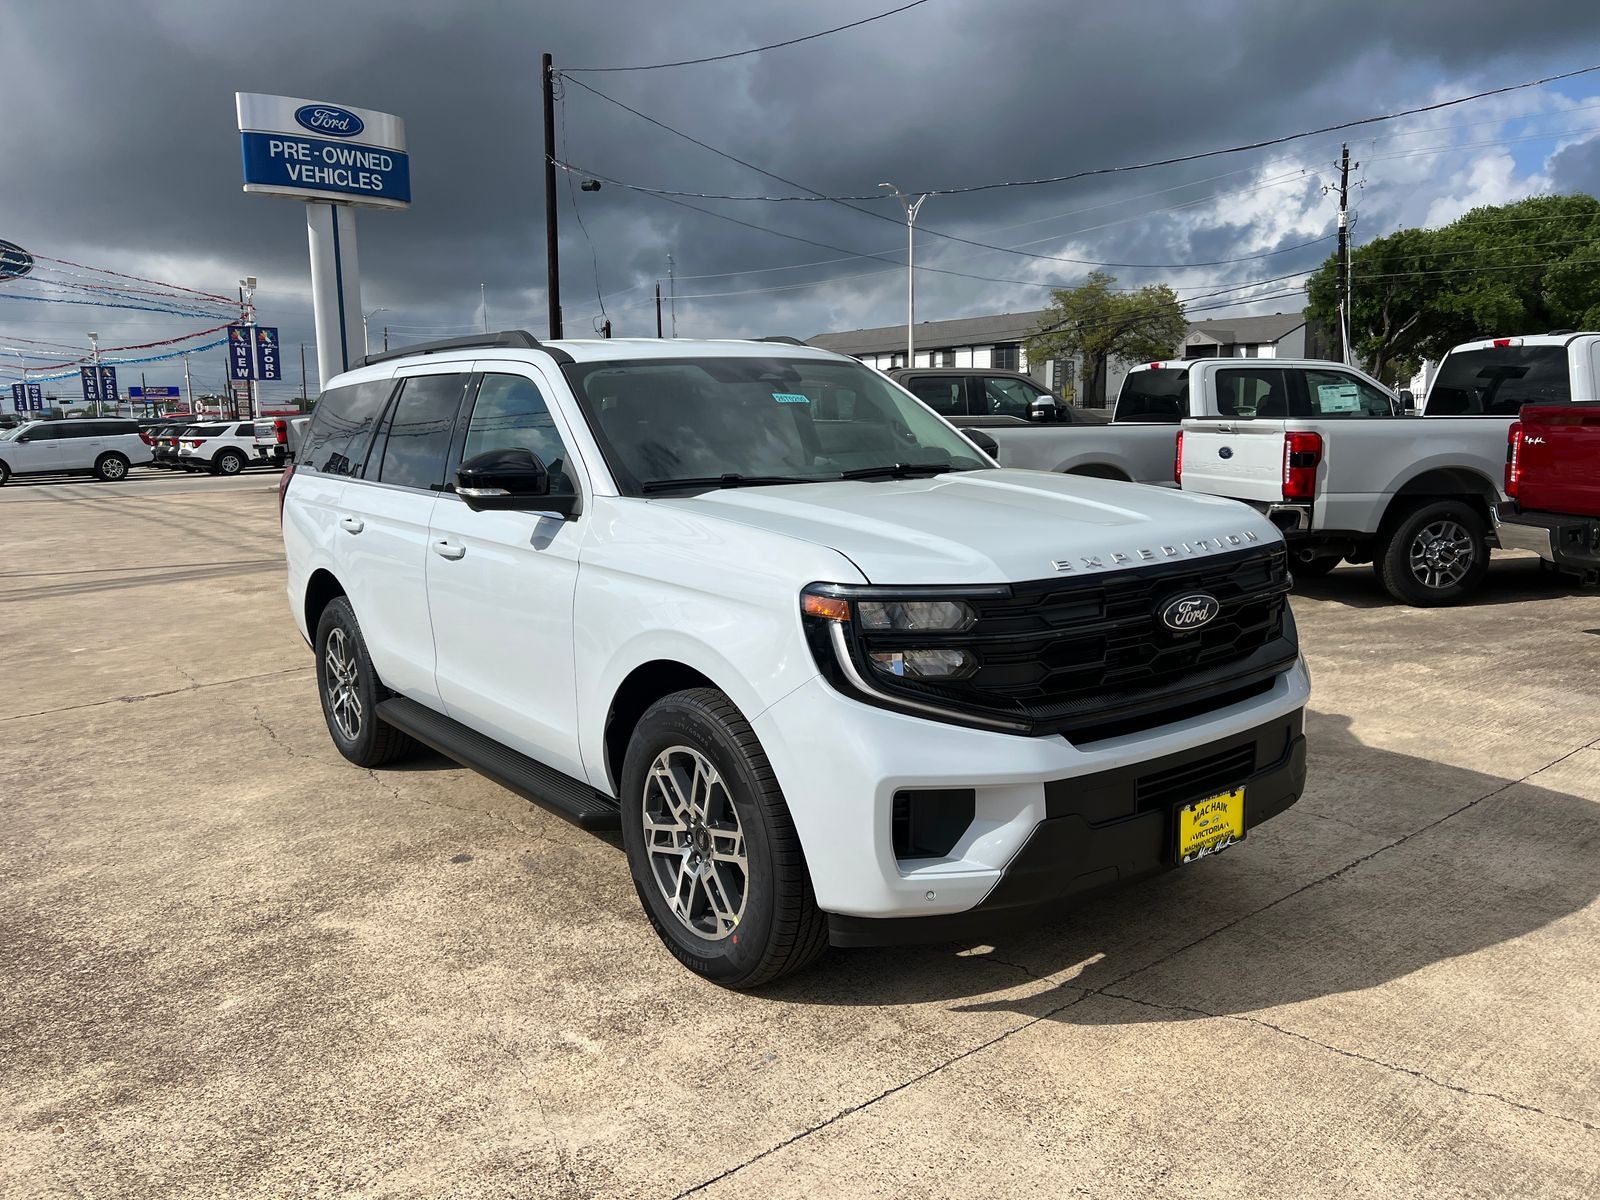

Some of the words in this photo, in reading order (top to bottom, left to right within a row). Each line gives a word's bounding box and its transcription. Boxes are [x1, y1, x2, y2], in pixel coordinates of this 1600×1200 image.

[310, 109, 350, 131] Ford
[286, 163, 383, 191] VEHICLES
[236, 347, 249, 377] NEW
[263, 348, 275, 378] FORD
[86, 379, 96, 399] NEW
[105, 379, 114, 399] FORD
[1051, 531, 1258, 572] EXPEDITION
[1175, 600, 1211, 626] Ford
[1193, 805, 1210, 825] MAC
[1210, 801, 1228, 813] HAIK
